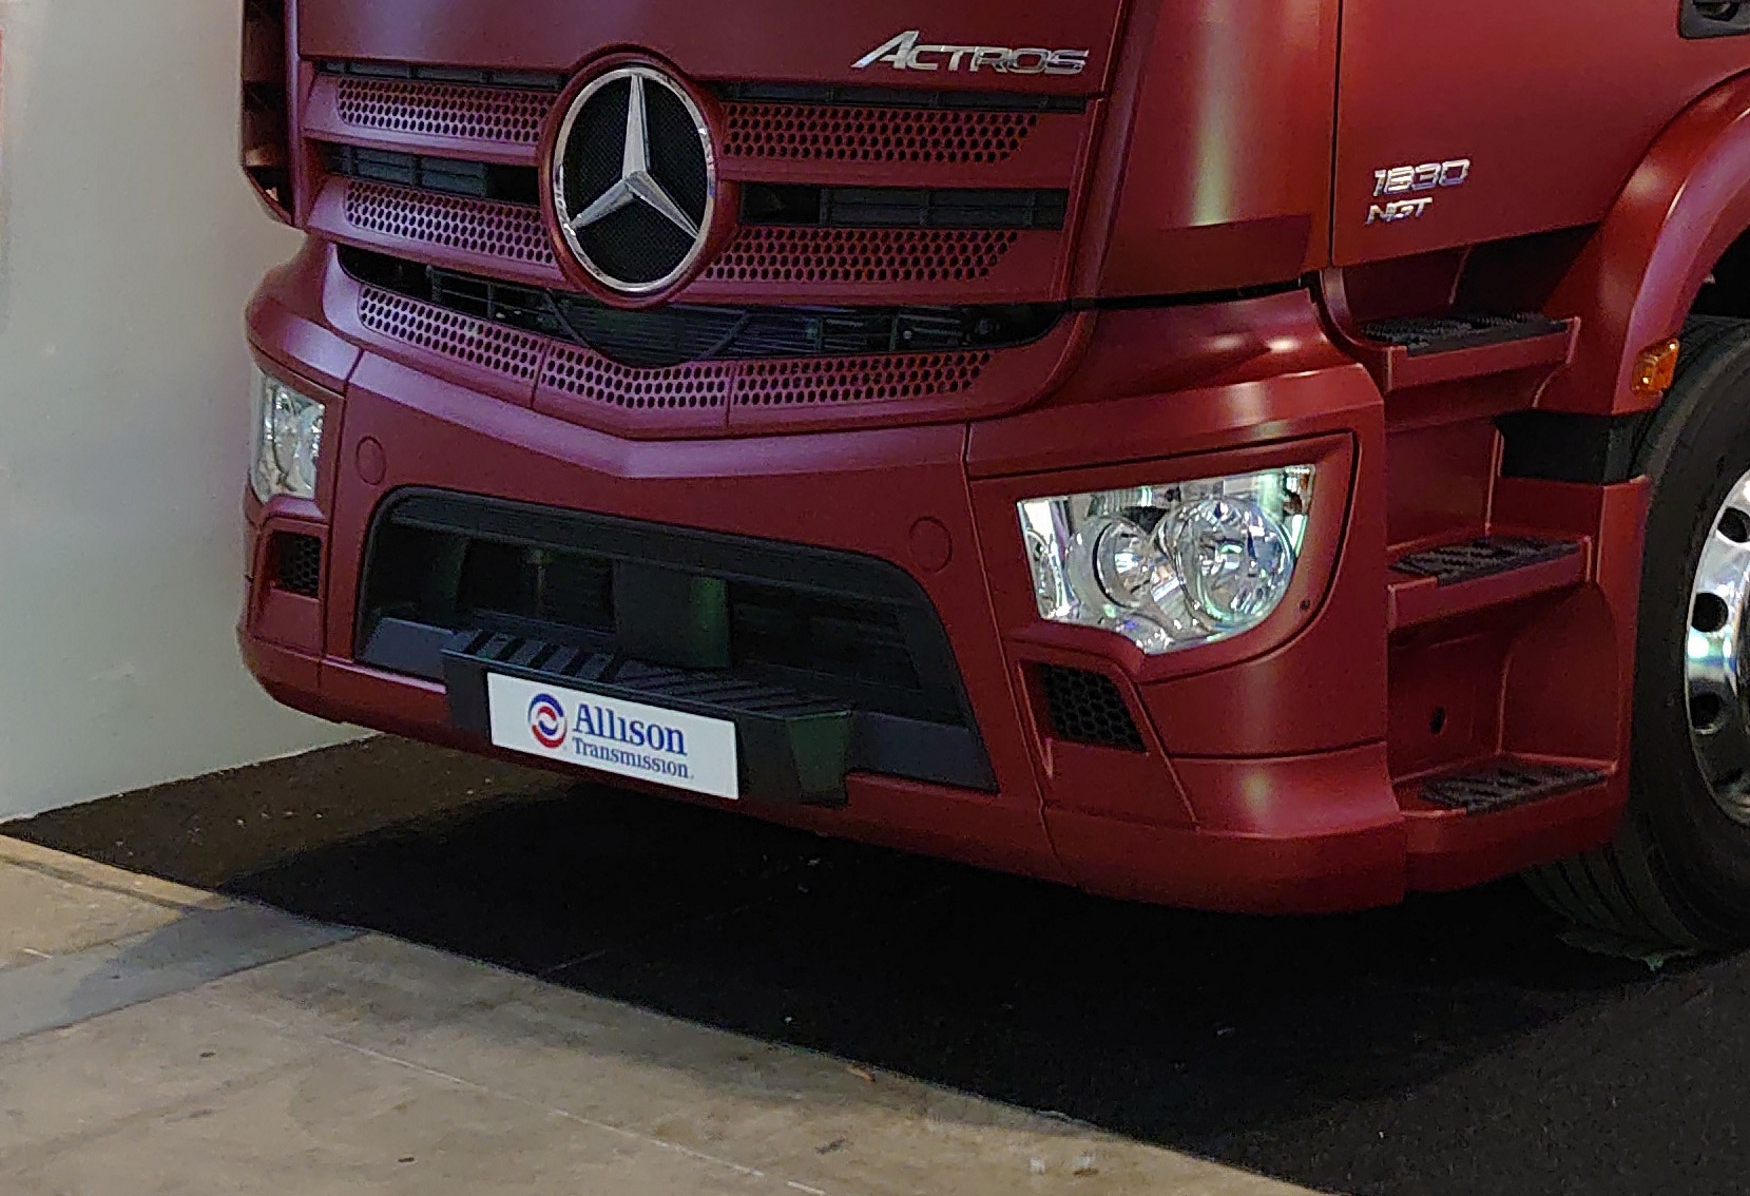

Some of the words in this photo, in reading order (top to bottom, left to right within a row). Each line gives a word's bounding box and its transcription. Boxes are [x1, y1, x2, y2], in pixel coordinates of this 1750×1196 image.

[1373, 159, 1470, 197] 1830
[1366, 197, 1433, 224] NGT
[572, 703, 688, 756] Allison
[572, 737, 690, 779] Transmission
